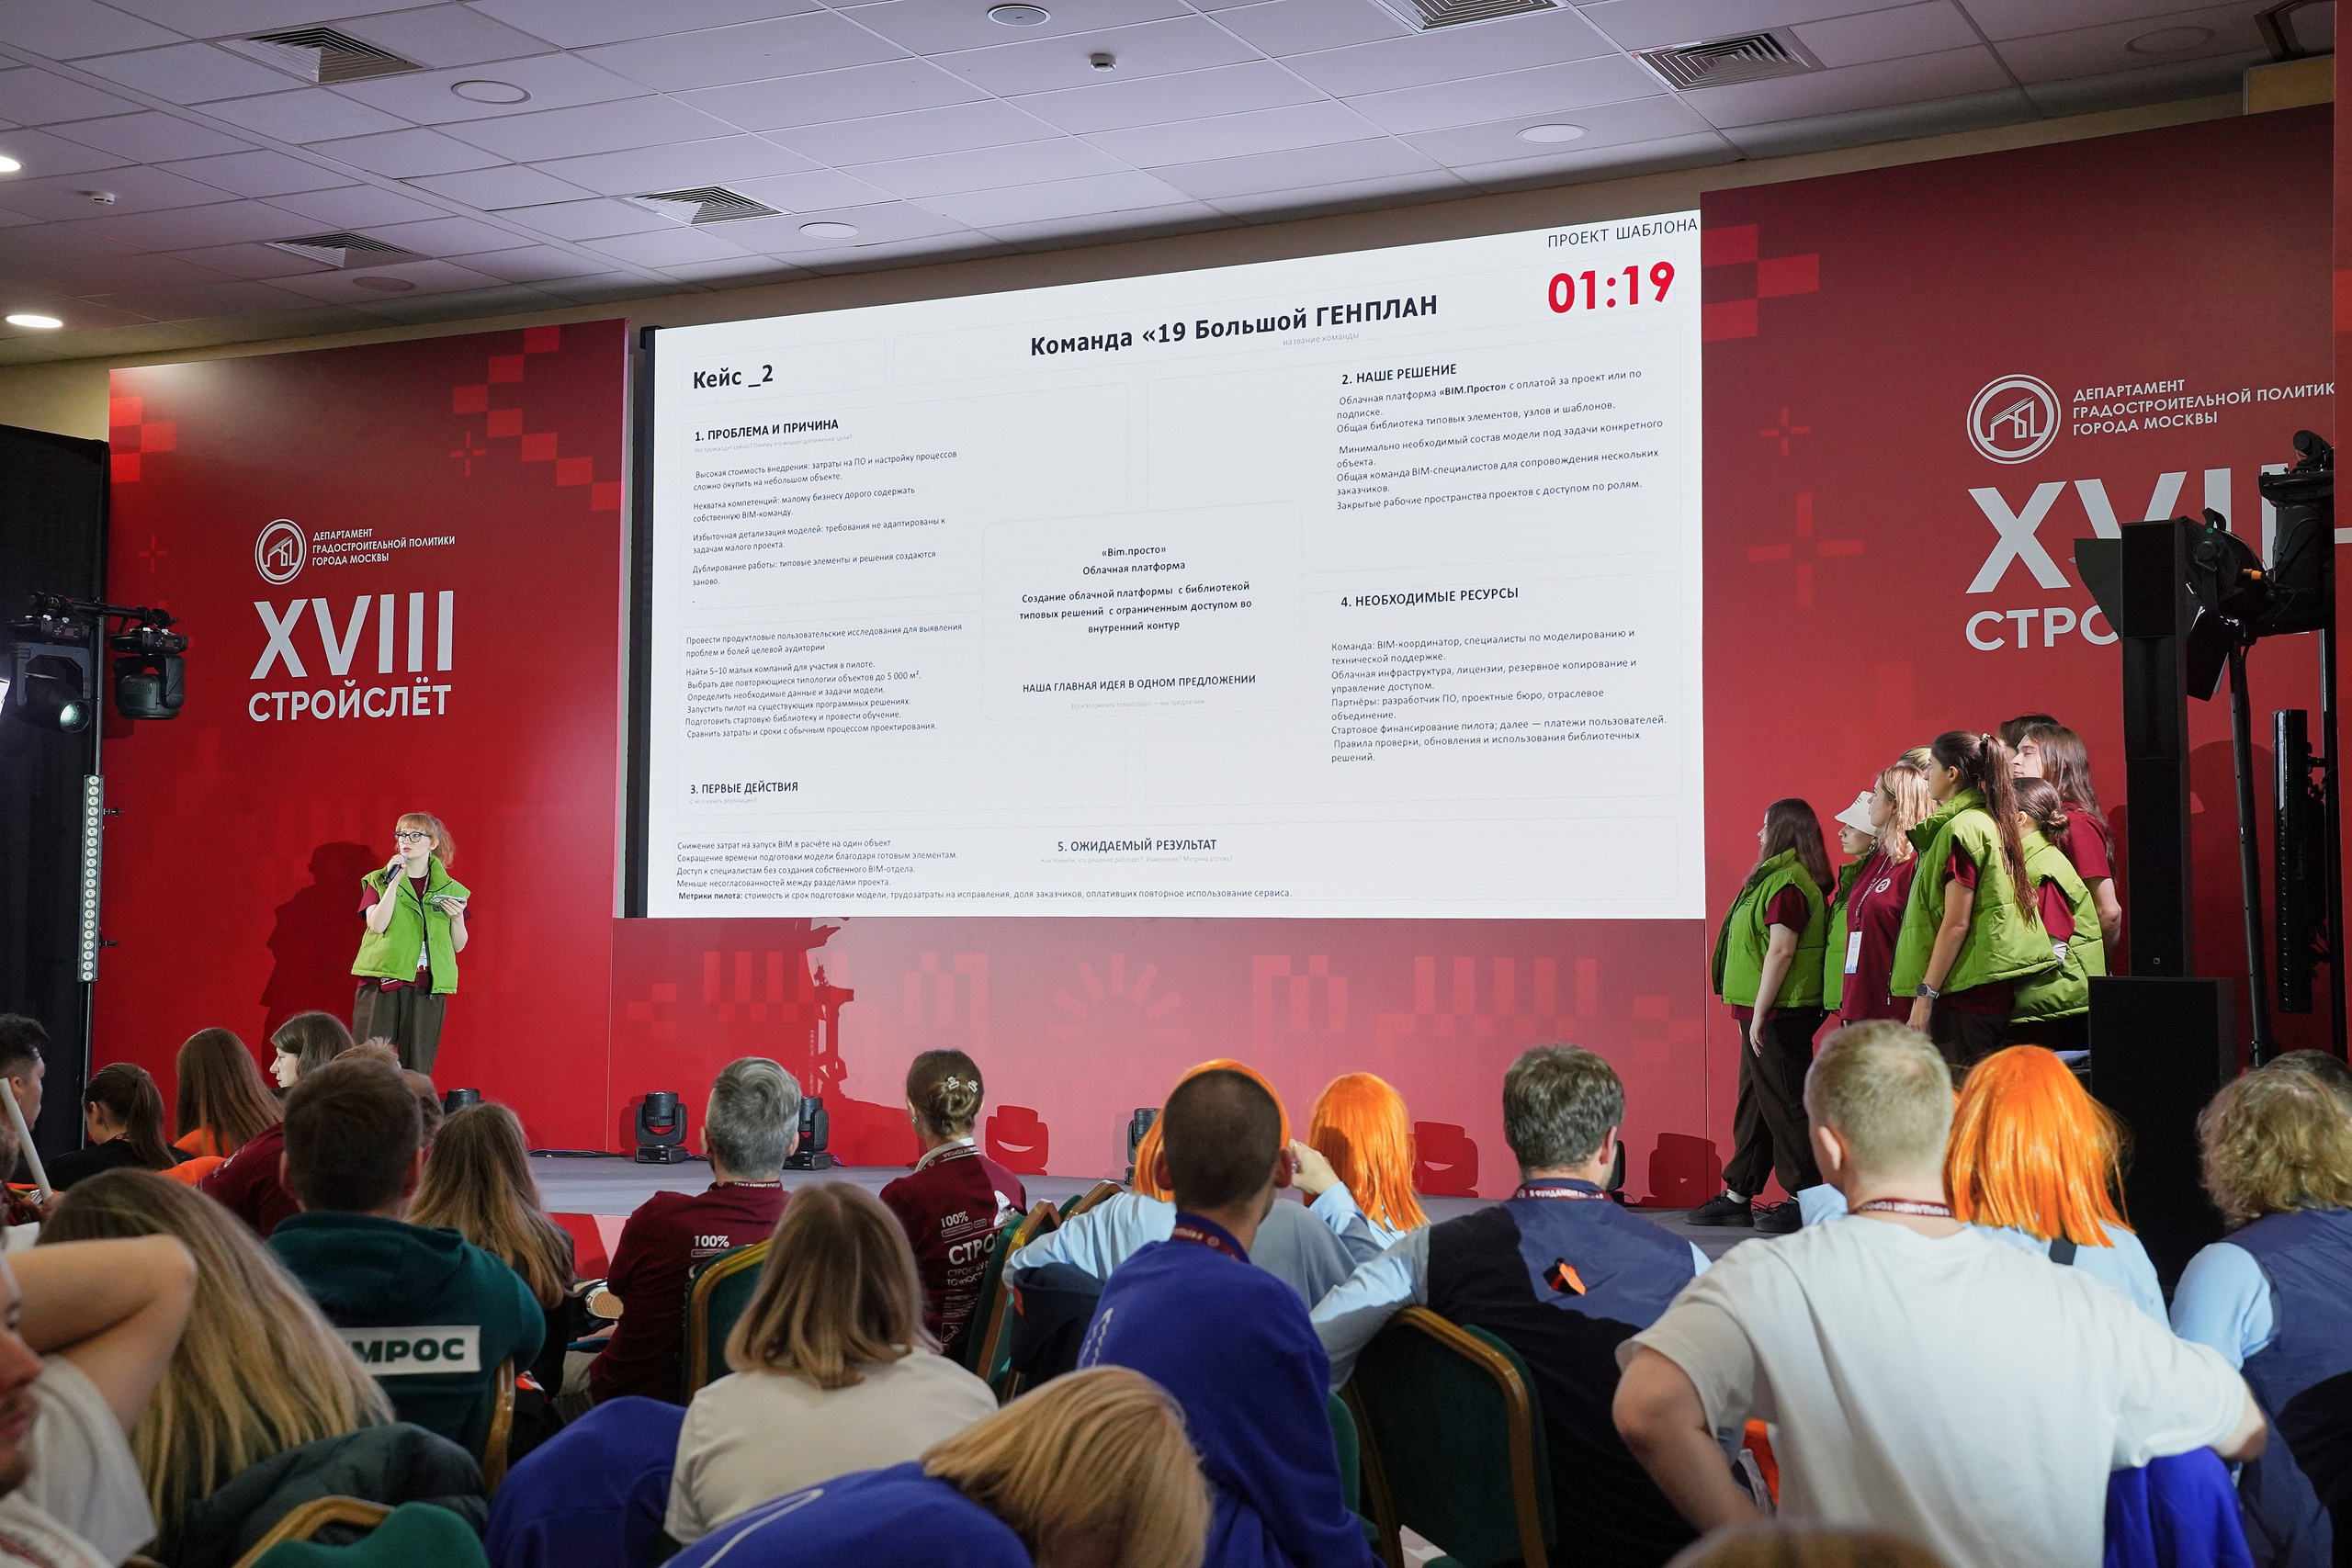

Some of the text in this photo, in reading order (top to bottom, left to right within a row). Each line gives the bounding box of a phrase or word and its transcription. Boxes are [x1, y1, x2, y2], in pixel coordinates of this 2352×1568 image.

[1548, 218, 1697, 247] ПРОЕКТ ШАБЛОНА
[1548, 261, 1675, 314] 01:19
[1031, 295, 1436, 355] Команда «19 Большой ГЕНПЛАН
[694, 367, 741, 389] Кейс
[1341, 363, 1456, 385] 2. НАШЕ РЕШЕНИЕ
[1339, 395, 1383, 405] Облачная
[1385, 389, 1436, 400] платформа
[1516, 377, 1555, 389] оплатой
[1571, 374, 1605, 385] проект
[1608, 372, 1625, 380] или
[2073, 378, 2186, 402] ДЕПАРТАМЕНТ
[2073, 382, 2335, 419] ГРАДОСТРОИТЕЛЬНОЙ ПОЛИТИК
[1336, 423, 1367, 433] Общая
[1370, 419, 1423, 430] библиотека
[1426, 415, 1465, 424] типовых
[1467, 411, 1521, 422] элементов,
[1523, 407, 1551, 418] узлов
[1562, 401, 1615, 412] шаблонов.
[1337, 409, 1383, 419] подписке.
[2073, 412, 2219, 436] ГОРОДА МОСКВЫ
[695, 419, 839, 441] 1. ПРОБЛЕМА И ПРИЧИНА
[695, 470, 726, 479] Высокая
[727, 467, 765, 476] стоимость
[766, 463, 809, 473] внедрения:
[811, 460, 842, 469] затраты
[854, 457, 865, 465] ПО
[874, 454, 914, 464] настройку
[915, 451, 956, 461] процессов
[693, 488, 915, 510] Нехватка компетенций: малому бизнесу дорого содержать
[693, 513, 741, 522] собственную
[312, 536, 456, 554] ГРАДОСТРОИТЕЛЬНОЙ ПОЛИТИКИ
[313, 528, 373, 542] ДЕПАРТАМЕНТ
[312, 553, 390, 566] ГОРОДА МОСКВЫ
[1102, 547, 1166, 557] «Bim.просто»
[1082, 561, 1185, 575] Облачная платформа
[1022, 593, 1066, 604] Создание
[1069, 589, 1114, 600] облачной
[1116, 587, 1172, 598] платформы
[1185, 581, 1250, 593] библиотекой
[1340, 587, 1518, 607] 4. НЕОБХОДИМЫЕ РЕСУРСЫ
[1019, 611, 1058, 619] типовых
[1061, 607, 1103, 619] решений
[1115, 604, 1187, 615] ограниченным
[1190, 601, 1238, 612] доступом
[1240, 600, 1251, 608] во
[250, 591, 453, 680] XVIII
[686, 637, 720, 645] Провести
[776, 630, 845, 639] пользовательские
[847, 627, 901, 636] исследования
[902, 626, 917, 635] для
[919, 624, 962, 632] выявления
[1088, 621, 1180, 634] внутренний контур
[1965, 606, 2121, 651] СТРО
[1331, 642, 1374, 651] Команда:
[1464, 636, 1526, 645] специалисты
[1543, 630, 1626, 641] моделированию
[685, 667, 707, 676] Найти
[754, 663, 792, 672] компаний
[792, 664, 807, 672] для
[808, 662, 838, 671] участия
[1331, 653, 1445, 664] технической поддержке.
[1331, 670, 1375, 679] Облачная
[1377, 668, 1453, 678] инфраструктура,
[1456, 666, 1505, 674] лицензии,
[1508, 662, 1559, 673] резервное
[1562, 660, 1628, 670] копирование
[1023, 674, 1255, 693] НАША ГЛАВНАЯ ИДЕЯ В ОДНОМ ПРЕДЛОЖЕНИИ
[249, 676, 452, 722] СТРОЙСЛЁТ
[690, 780, 797, 795] 3. ПЕРВЫЕ ДЕЙСТВИЯ
[677, 841, 715, 850] Снижение
[752, 841, 776, 850] запуск
[800, 840, 830, 849] расчёте
[864, 838, 893, 847] объект.
[1057, 839, 1216, 853] 5. ОЖИДАЕМЫЙ РЕЗУЛЬТАТ
[676, 866, 702, 876] Доступ
[709, 867, 762, 875] специалистам
[763, 865, 776, 874] без
[814, 864, 866, 874] собственного
[941, 1211, 968, 1228] 100%
[694, 1235, 730, 1247] 100%
[948, 1232, 999, 1265] СТРО
[351, 1337, 465, 1362] МРОС
